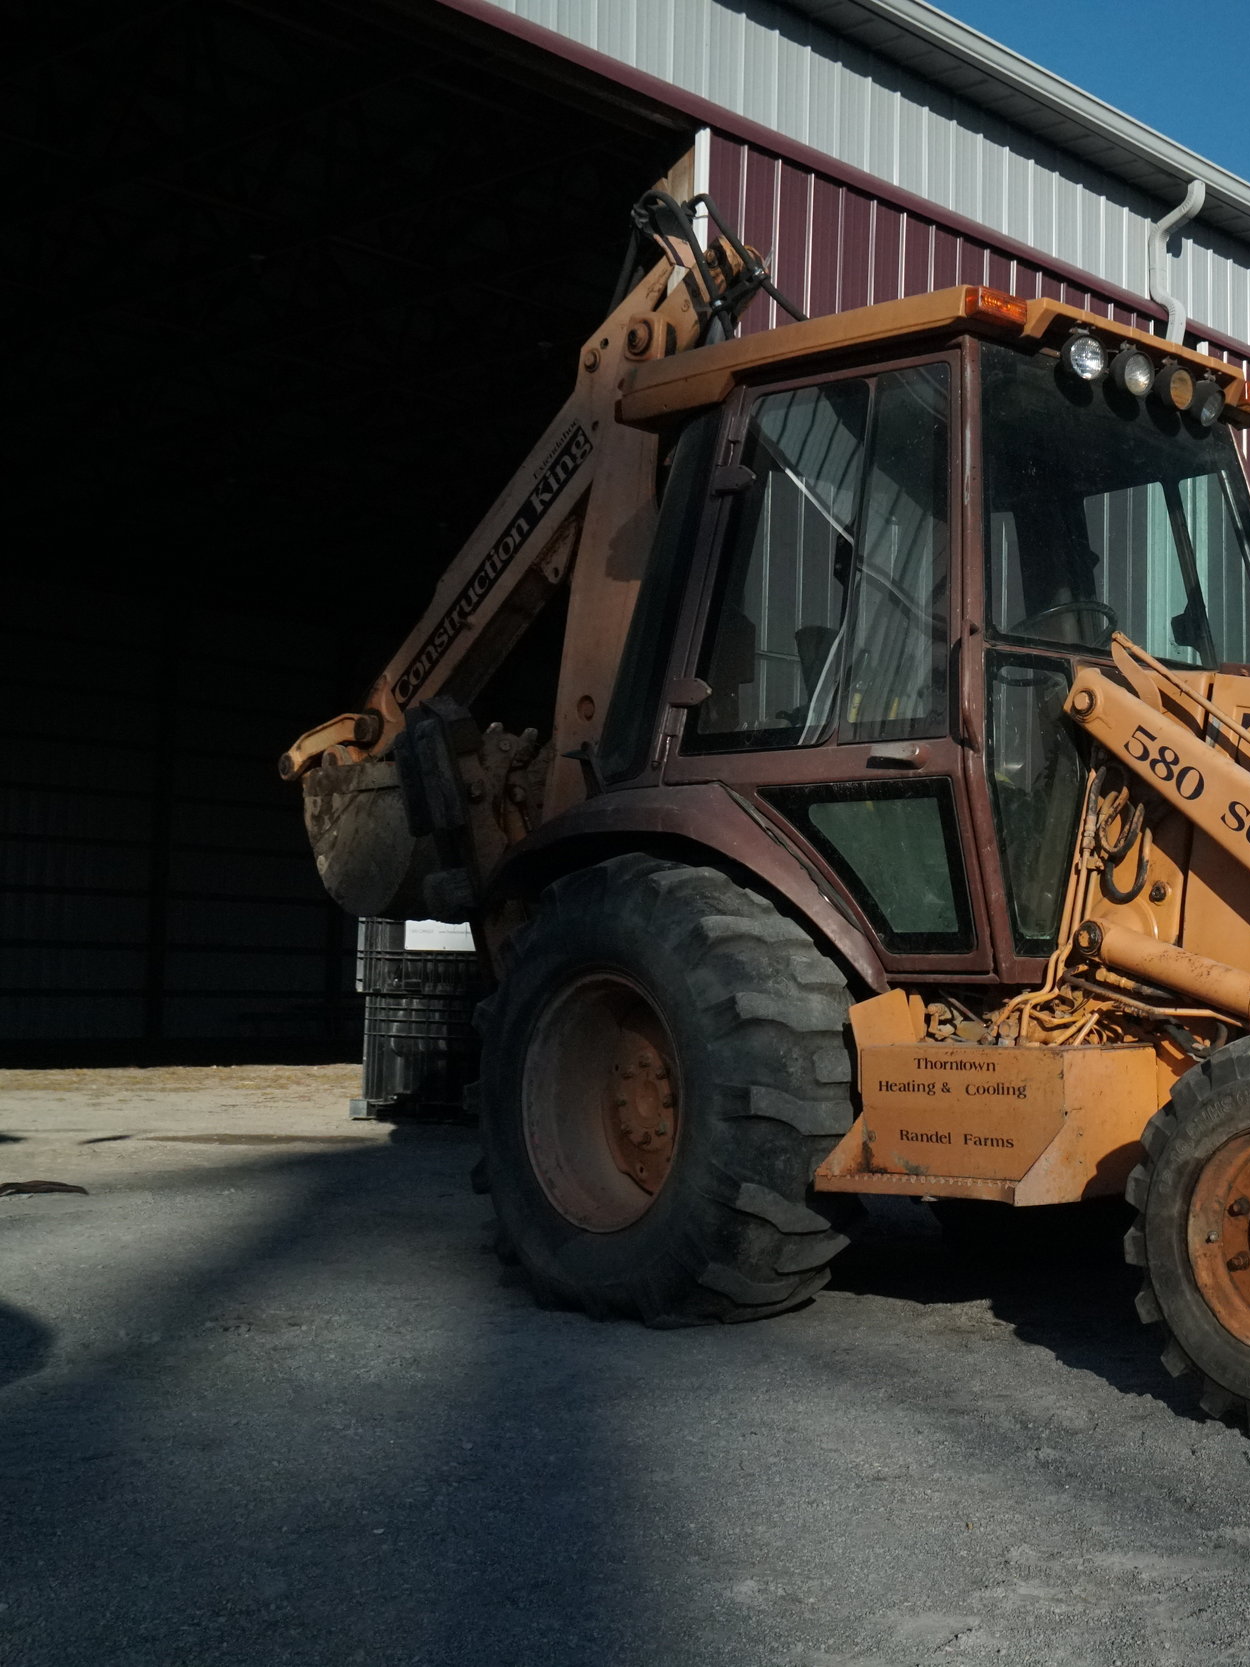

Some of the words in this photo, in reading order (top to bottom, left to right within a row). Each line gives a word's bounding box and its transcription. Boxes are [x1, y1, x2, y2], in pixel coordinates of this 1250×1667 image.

[394, 518, 531, 704] Construction
[530, 428, 592, 515] King
[1123, 724, 1205, 801] 580
[913, 1057, 996, 1072] Thorntown
[878, 1080, 936, 1096] Heating
[940, 1082, 952, 1094] &
[965, 1082, 1027, 1099] Cooling
[899, 1129, 952, 1145] Randel
[963, 1133, 1015, 1149] Farms
